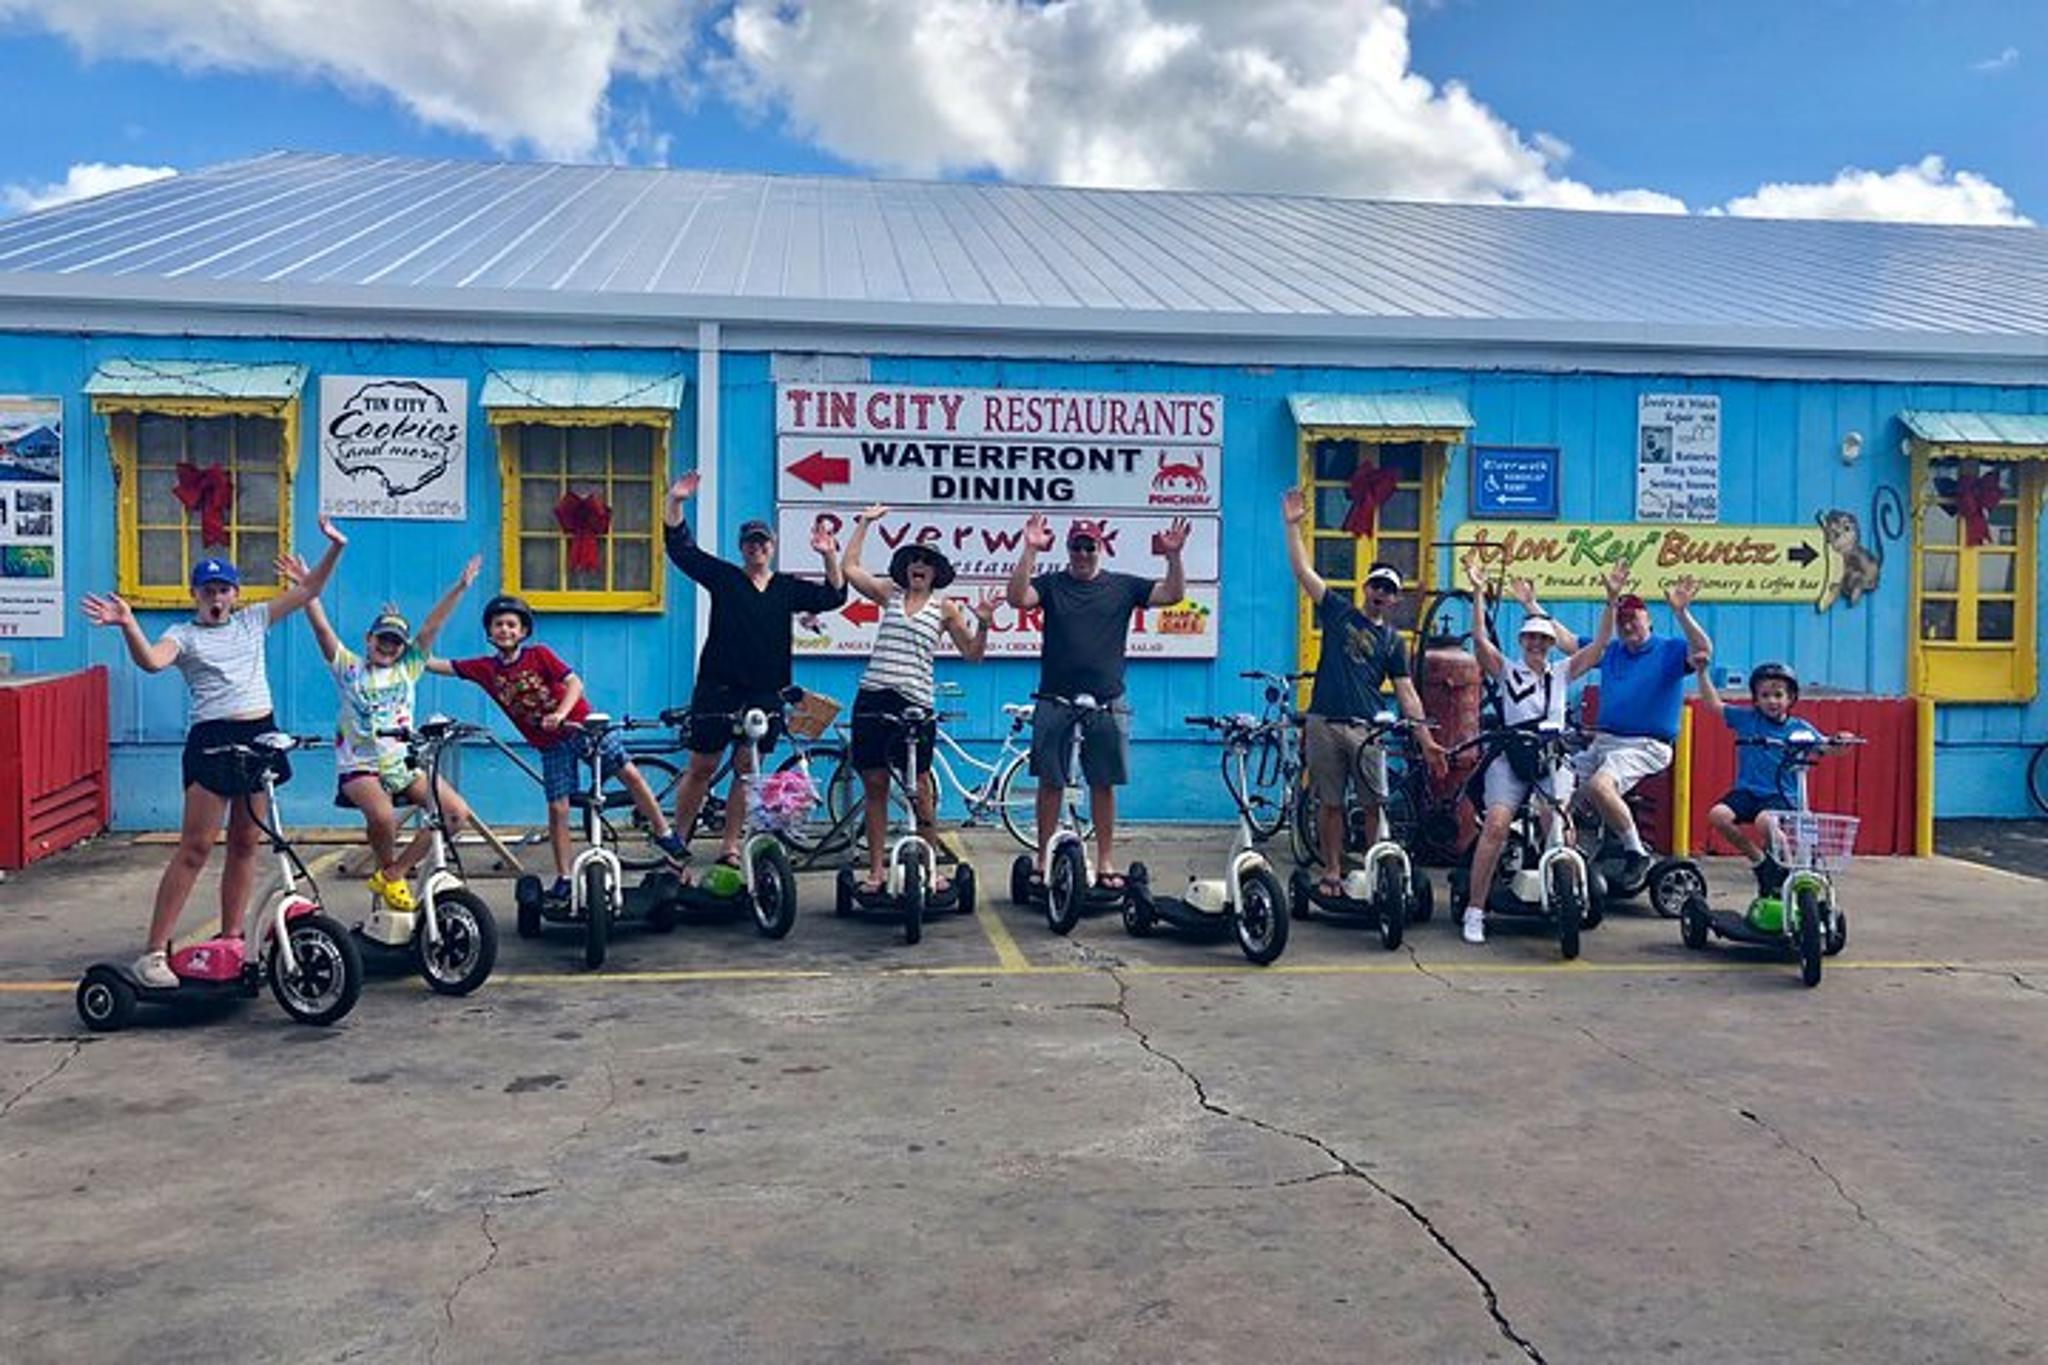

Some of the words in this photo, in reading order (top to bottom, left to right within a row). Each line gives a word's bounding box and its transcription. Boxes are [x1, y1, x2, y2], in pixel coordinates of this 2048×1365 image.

[364, 397, 390, 411] TIN
[394, 397, 427, 413] CITY
[787, 390, 857, 429] TIN
[865, 392, 965, 432] CITY
[983, 397, 1216, 437] RESTAURANTS
[329, 409, 459, 442] Cookies
[388, 446, 439, 460] more
[861, 441, 1142, 474] WATERFRONT
[931, 475, 1075, 502] DINING
[1658, 529, 1781, 567] Buntz
[1544, 574, 1585, 587] Bread
[1760, 576, 1795, 595] Coffee
[1798, 577, 1820, 589] Bar
